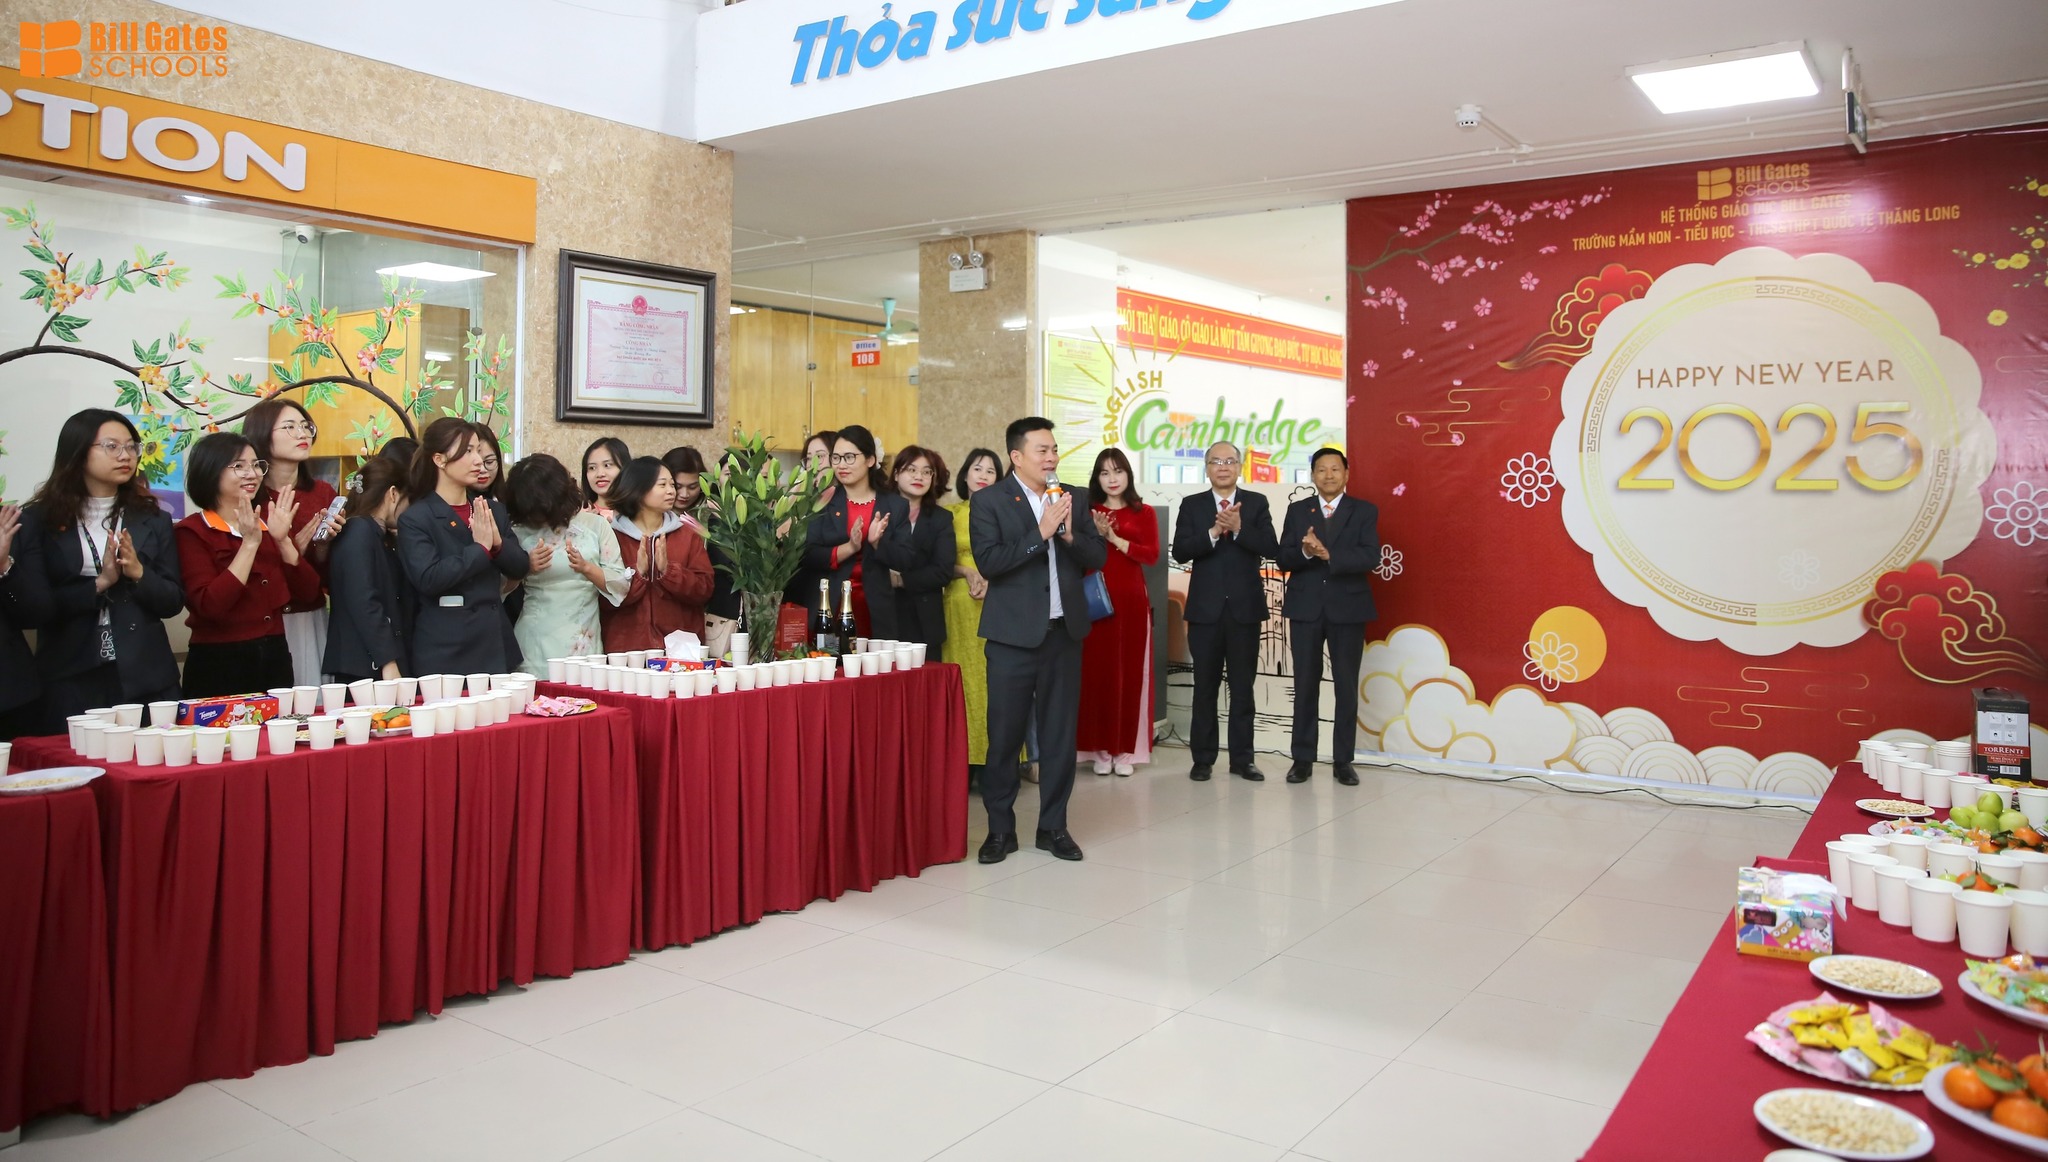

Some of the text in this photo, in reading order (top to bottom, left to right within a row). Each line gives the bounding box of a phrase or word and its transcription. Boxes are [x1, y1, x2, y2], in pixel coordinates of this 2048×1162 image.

[790, 3, 938, 86] Thỏa
[0, 88, 306, 191] TION
[1736, 163, 1810, 183] Bill Gates
[1736, 179, 1810, 197] SCHOOLS
[1661, 208, 1675, 227] HỆ
[1679, 202, 1717, 222] THỐNG
[1722, 201, 1749, 218] GIÁO
[1781, 198, 1806, 212] BILL
[1811, 194, 1852, 209] GATES
[1573, 235, 1616, 251] TRƯỜNG
[1649, 231, 1671, 244] NON
[1684, 222, 1708, 242] TIỂU
[1712, 225, 1734, 243] HỌC
[1878, 207, 1921, 225] THĂNG
[1925, 205, 1960, 222] LONG
[1159, 311, 1180, 343] GIÁO,
[1181, 314, 1191, 341] CÔ
[1192, 317, 1209, 345] GIÁO
[1210, 320, 1219, 346] LÀ
[856, 353, 874, 364] 108
[1637, 360, 1894, 389] HAPPY NEW YEAR
[1103, 370, 1162, 446] ENGLISH
[1125, 397, 1322, 465] Cambridge
[1618, 402, 1923, 491] 2025
[199, 710, 217, 720] Tempo
[1984, 746, 2024, 755] TORRENTE
